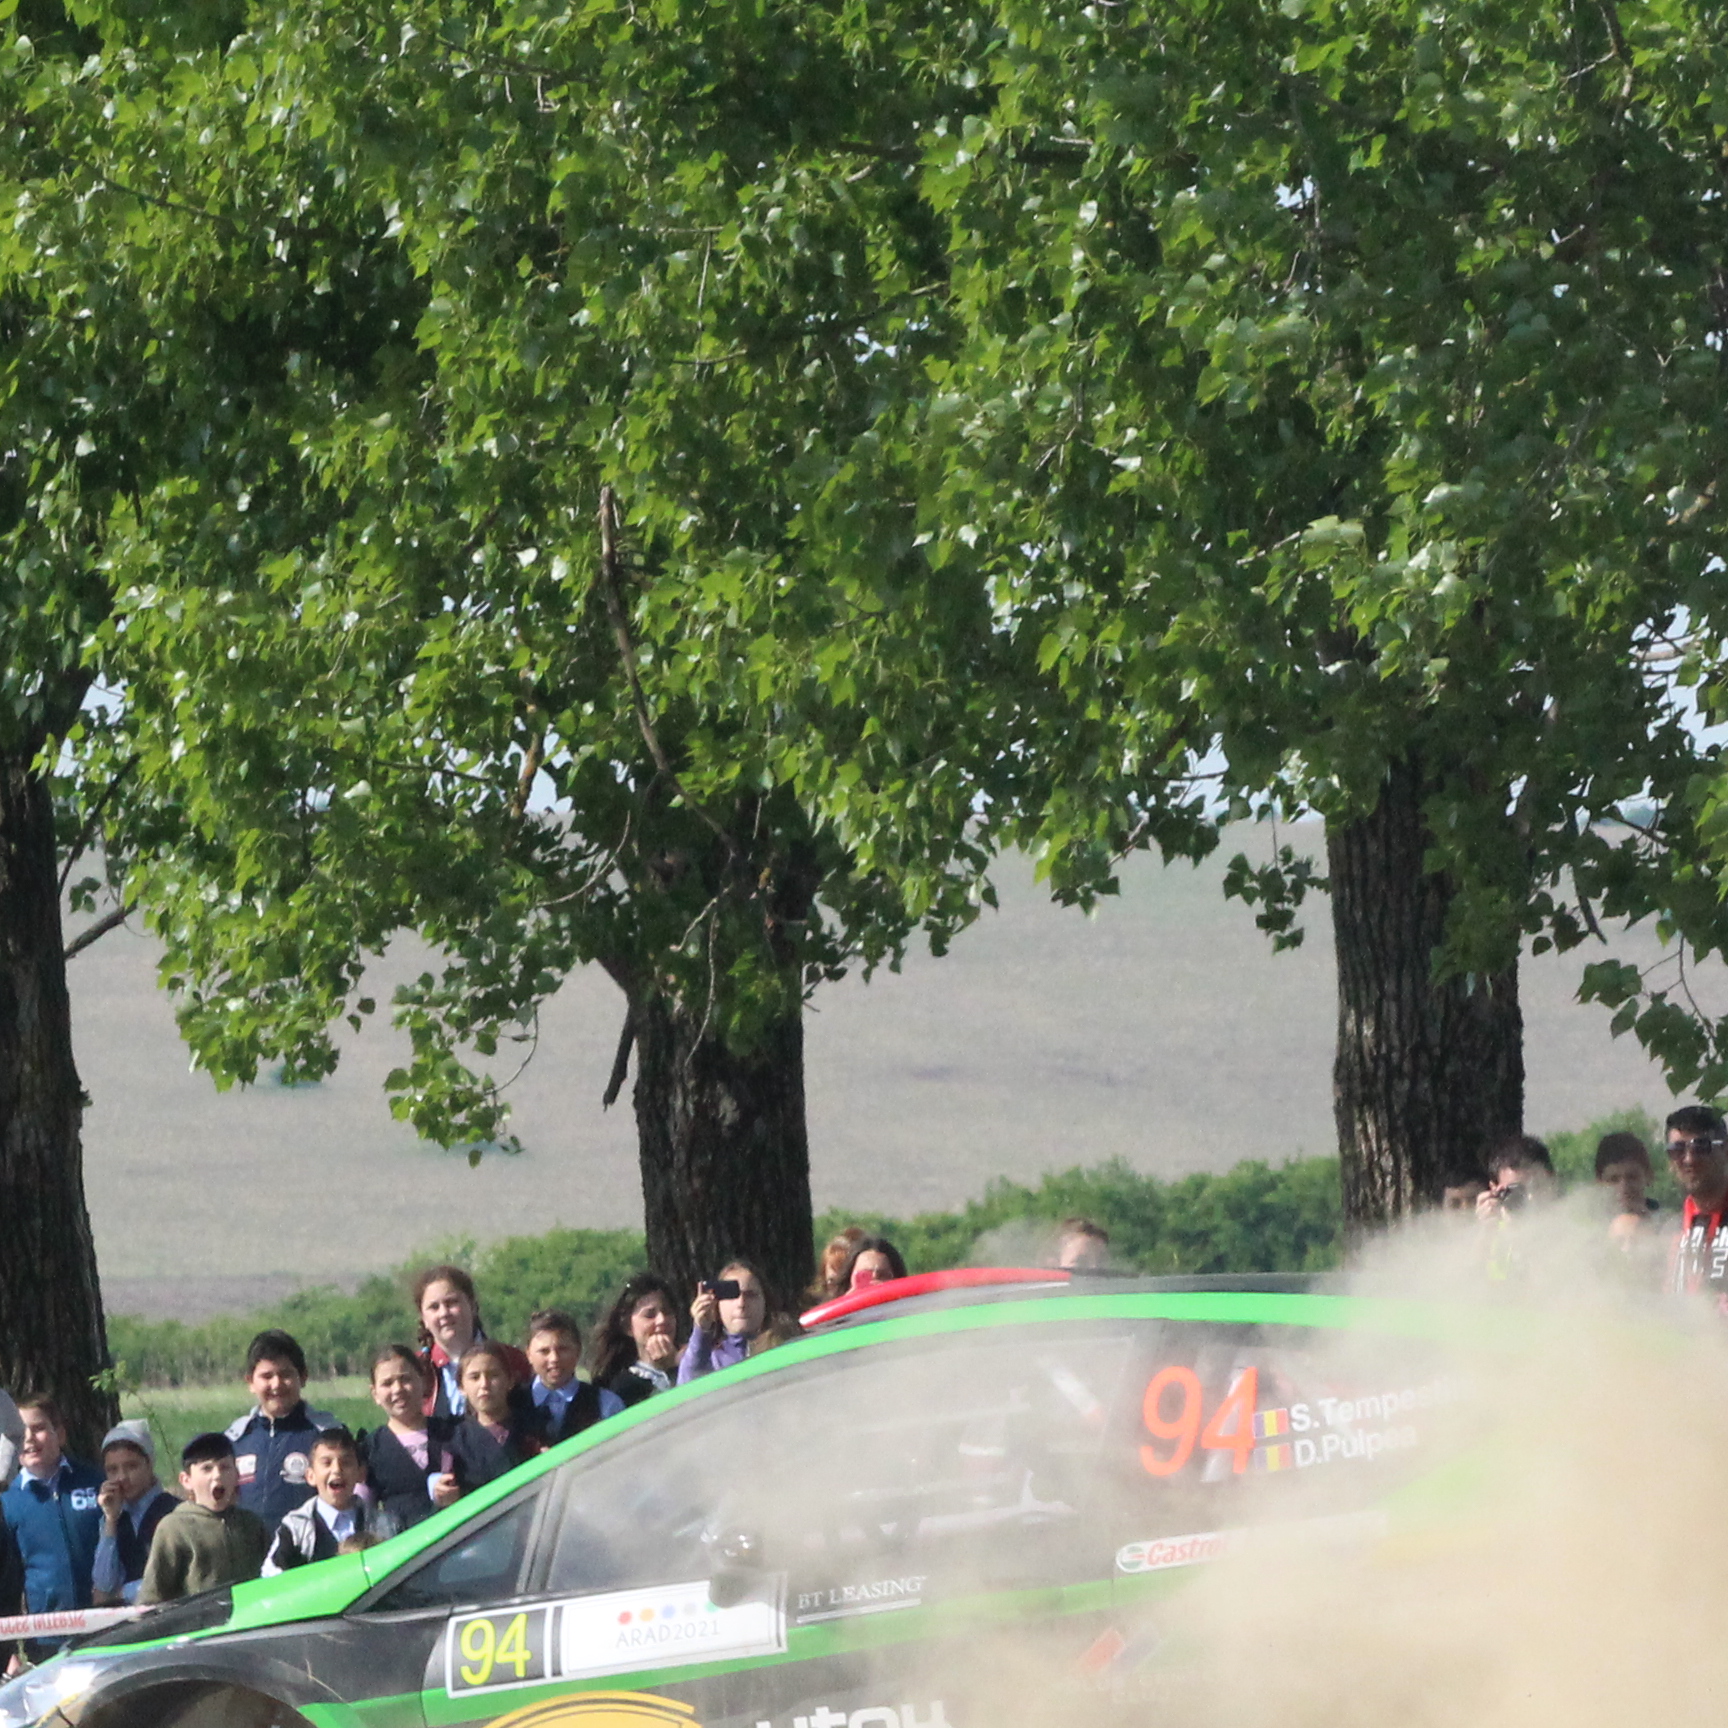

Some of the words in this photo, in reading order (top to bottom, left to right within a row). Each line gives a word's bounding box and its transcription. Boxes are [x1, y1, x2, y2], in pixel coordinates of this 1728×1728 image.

[1139, 1366, 1259, 1476] 94
[1147, 1537, 1229, 1566] Castro
[798, 1591, 824, 1609] BT
[829, 1576, 923, 1605] LEASING
[459, 1613, 532, 1686] 94
[615, 1620, 722, 1649] ARAD2021
